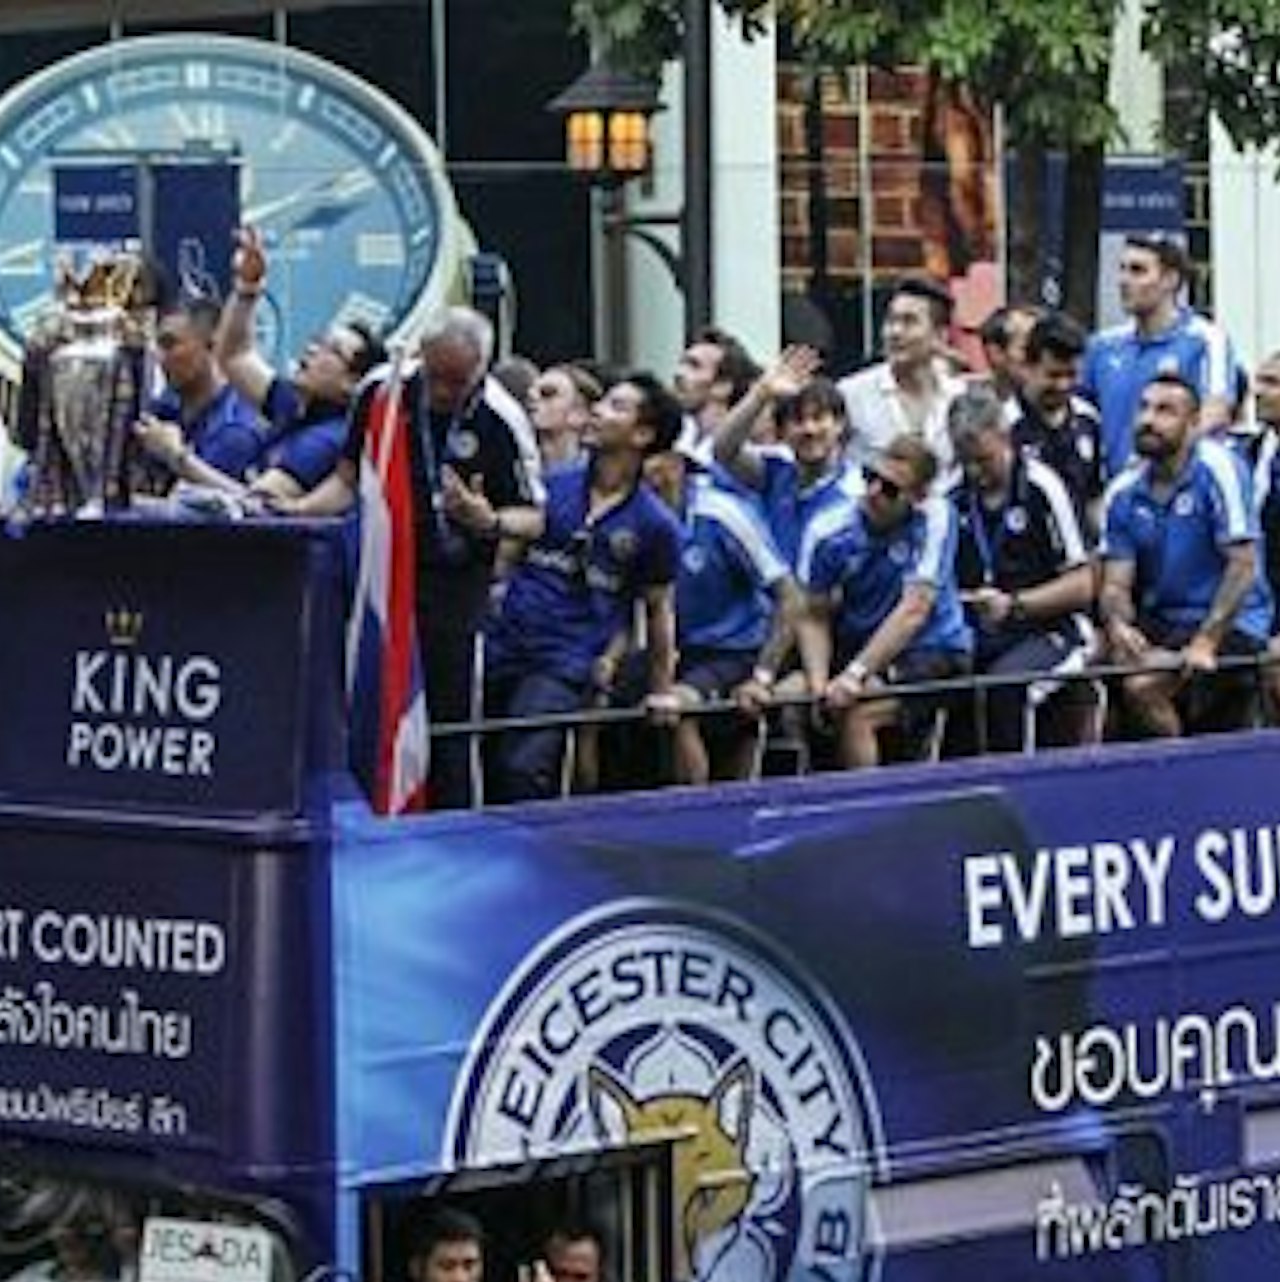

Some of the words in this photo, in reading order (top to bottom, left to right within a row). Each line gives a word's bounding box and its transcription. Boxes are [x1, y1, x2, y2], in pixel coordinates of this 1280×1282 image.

[71, 650, 222, 722] KING
[67, 721, 216, 776] POWER
[963, 834, 1173, 949] EVERY
[32, 908, 226, 974] COUNTED
[498, 947, 756, 1156] EICESTER
[763, 1008, 851, 1163] CITY
